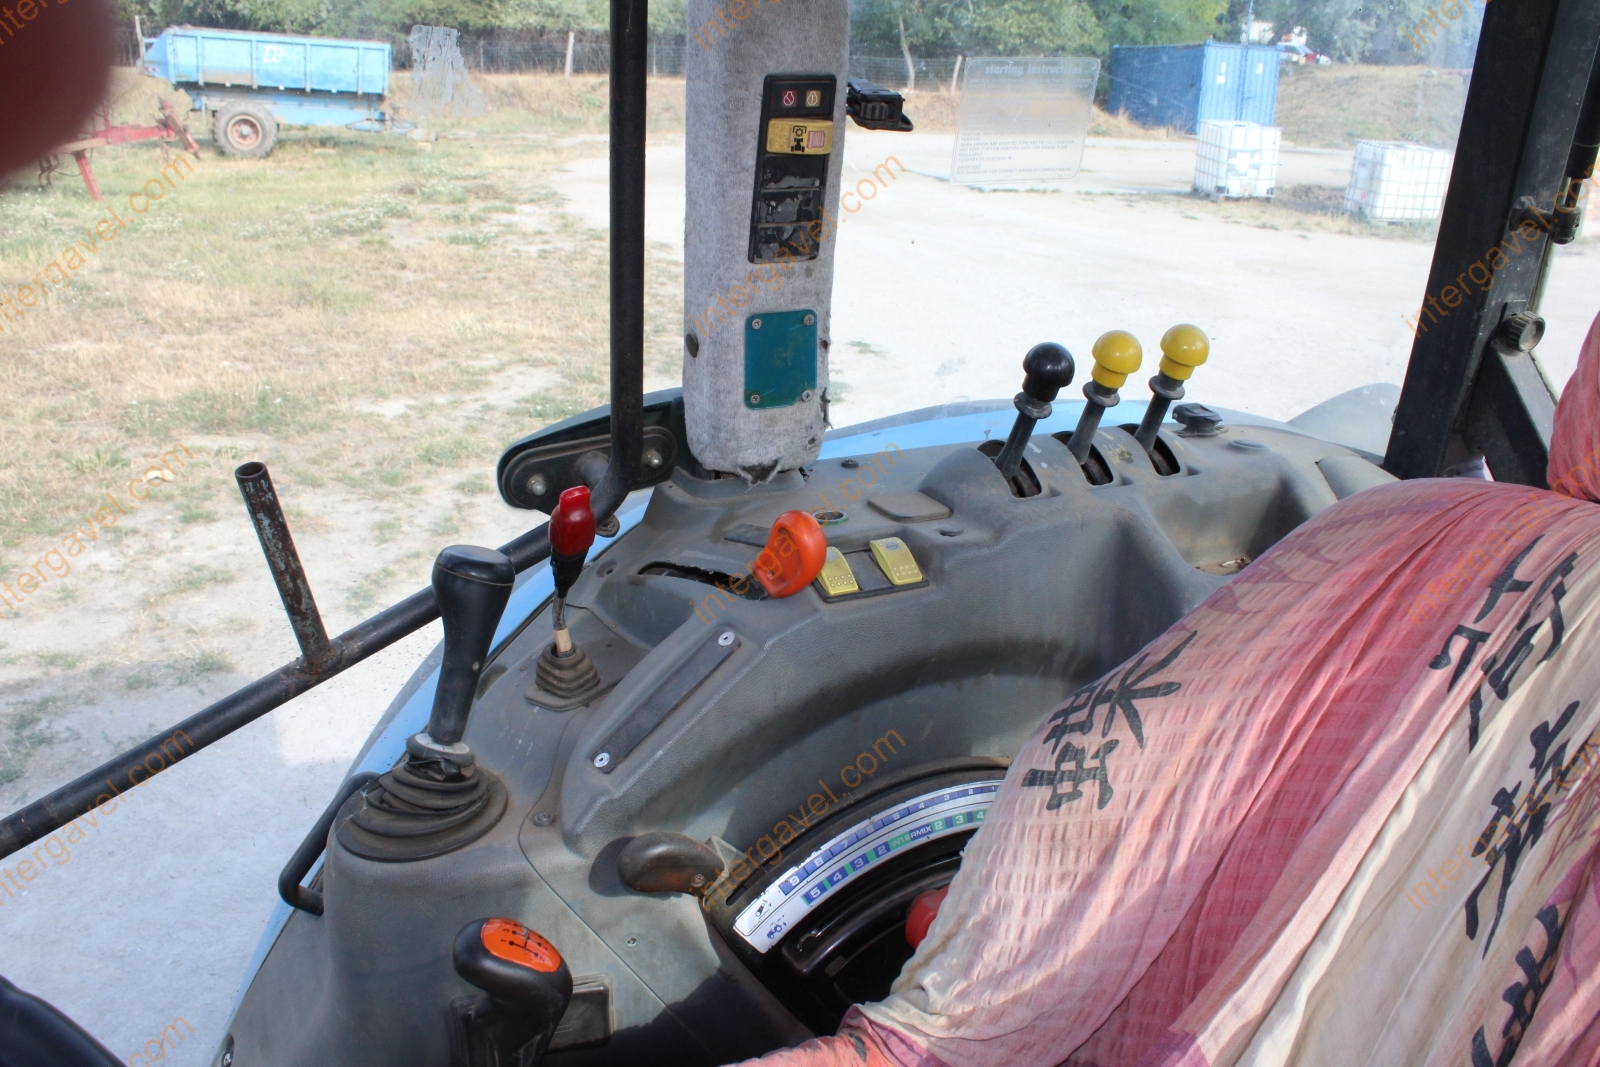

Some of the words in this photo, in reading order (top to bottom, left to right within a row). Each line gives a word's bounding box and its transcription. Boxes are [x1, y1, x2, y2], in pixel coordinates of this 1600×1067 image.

[985, 64, 1023, 77] starting
[1028, 64, 1082, 74] instructions
[789, 876, 800, 886] 9
[814, 858, 824, 866] 8
[840, 839, 849, 849] 7
[892, 812, 900, 820] 5
[810, 888, 821, 898] 5
[833, 871, 842, 882] 4
[854, 858, 864, 868] 3
[877, 845, 887, 855] 2
[891, 825, 933, 847] INTERMIX
[934, 821, 943, 830] 2
[955, 815, 964, 824] 3
[976, 811, 985, 819] 4
